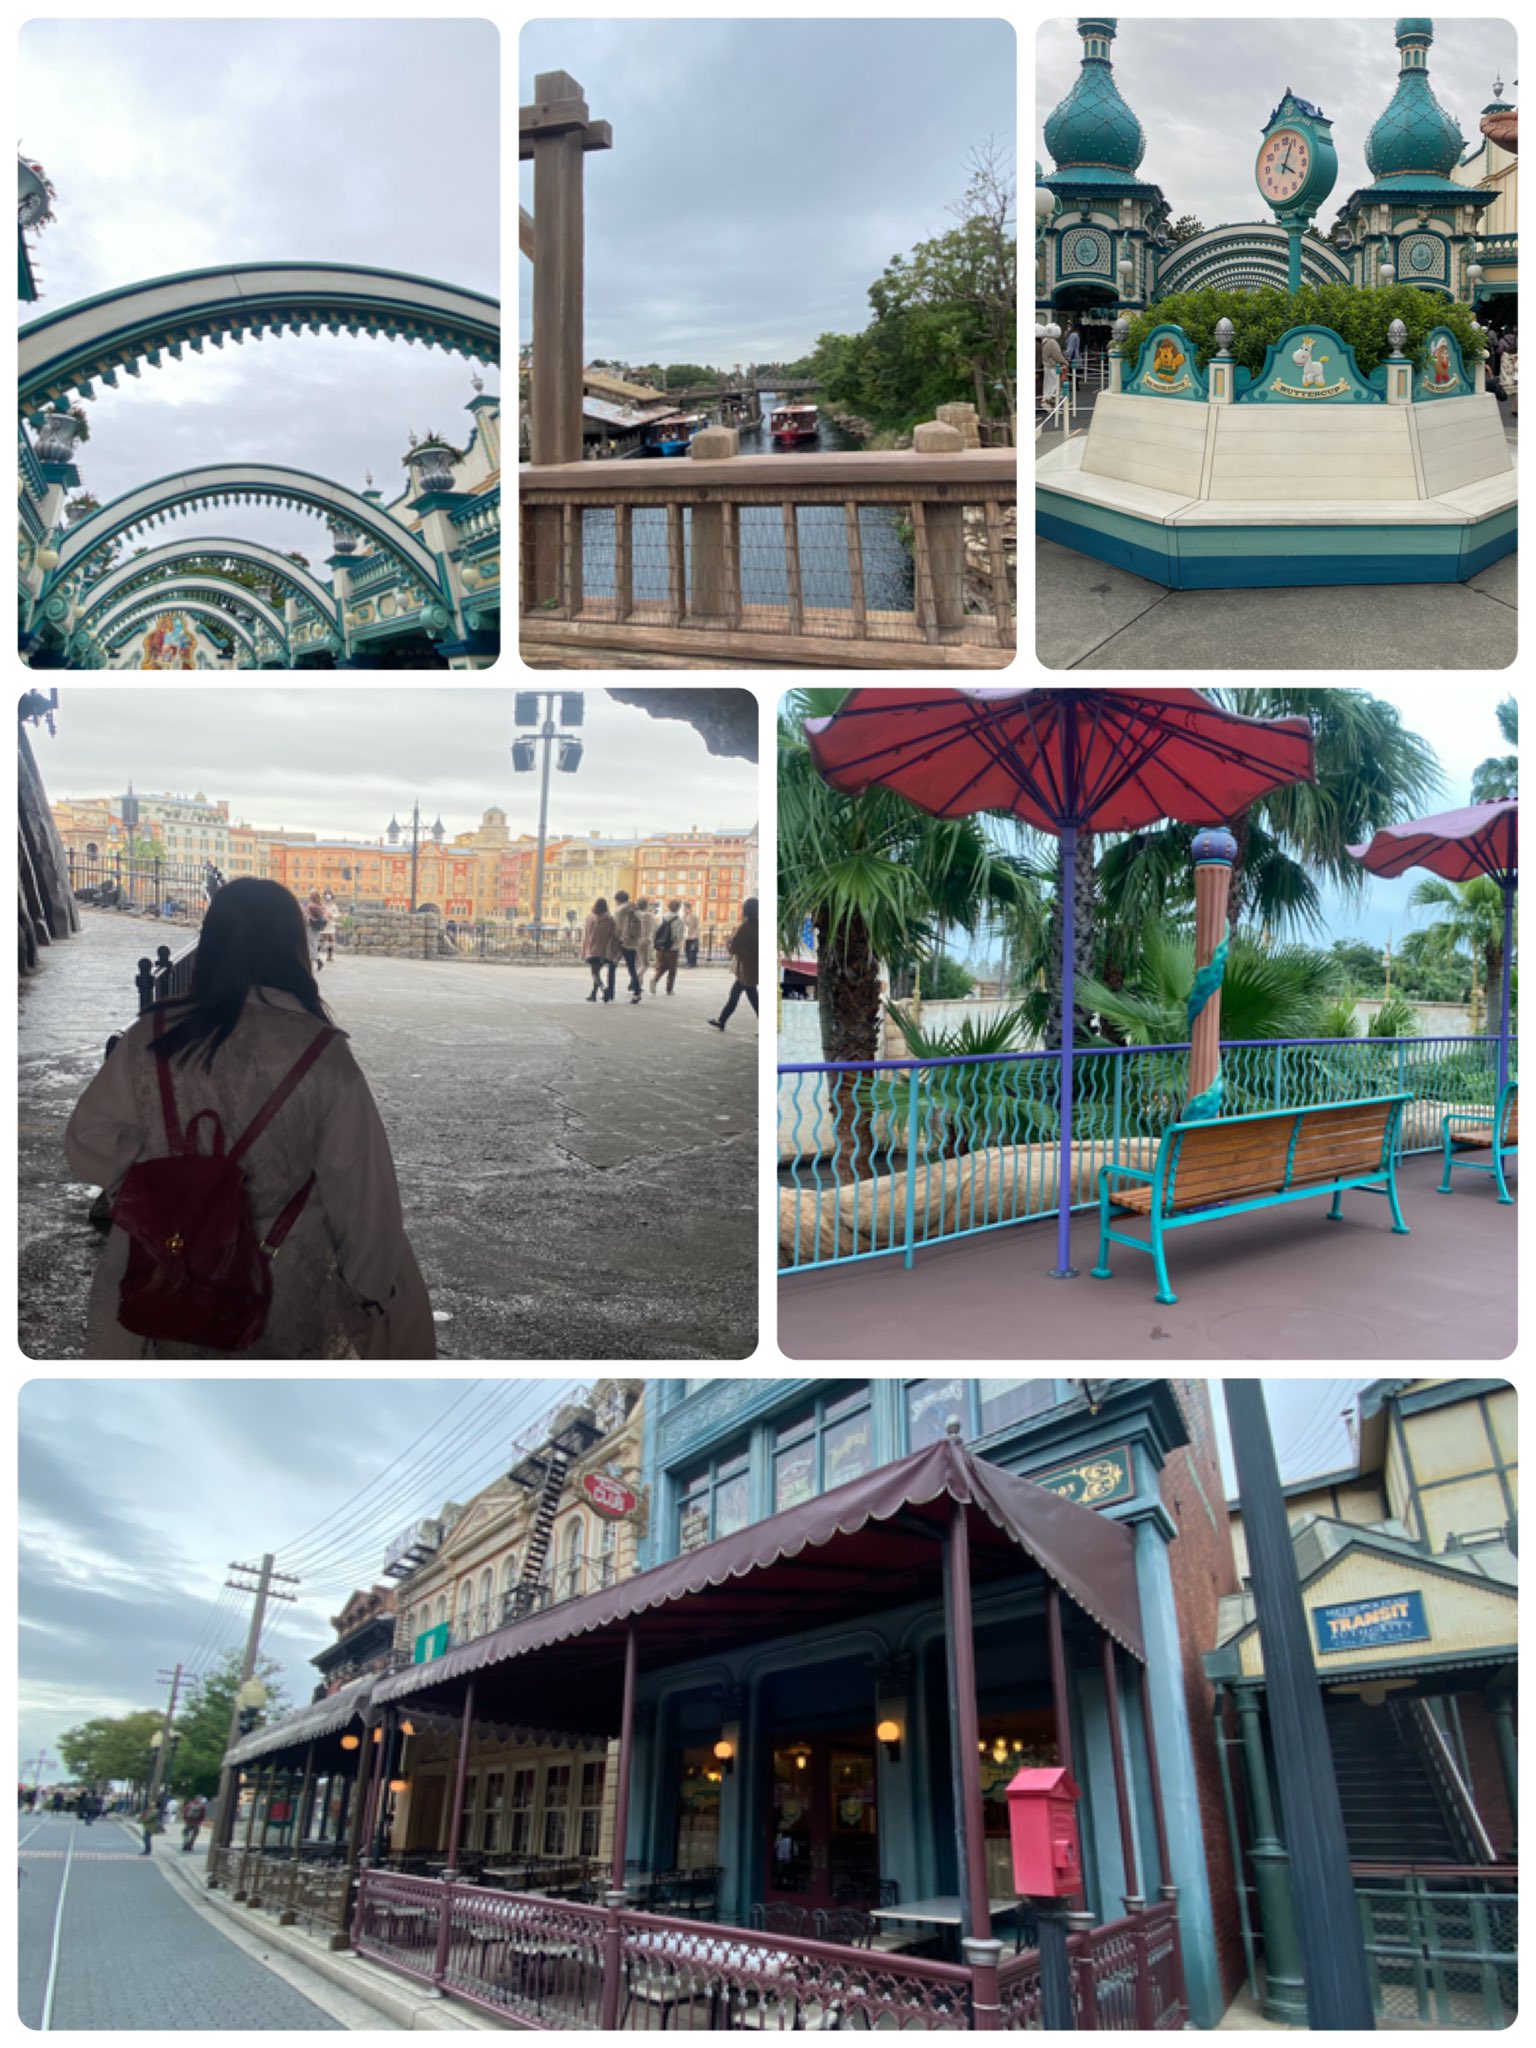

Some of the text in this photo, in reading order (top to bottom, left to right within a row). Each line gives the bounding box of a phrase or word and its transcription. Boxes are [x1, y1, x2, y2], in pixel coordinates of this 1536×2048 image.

[1281, 137, 1289, 146] 12
[1293, 138, 1297, 147] 1
[1274, 143, 1280, 152] 11
[1299, 145, 1305, 155] 2
[1267, 153, 1275, 162] 10
[1301, 158, 1307, 167] 3
[1265, 166, 1271, 174] 9
[1298, 172, 1304, 180] 4
[1267, 178, 1272, 186] 8
[1292, 181, 1297, 191] 5
[1273, 185, 1279, 194] 7
[1282, 187, 1288, 195] 6
[1279, 385, 1341, 398] BUTTERCUP
[1328, 1603, 1409, 1633] TRANSIT
